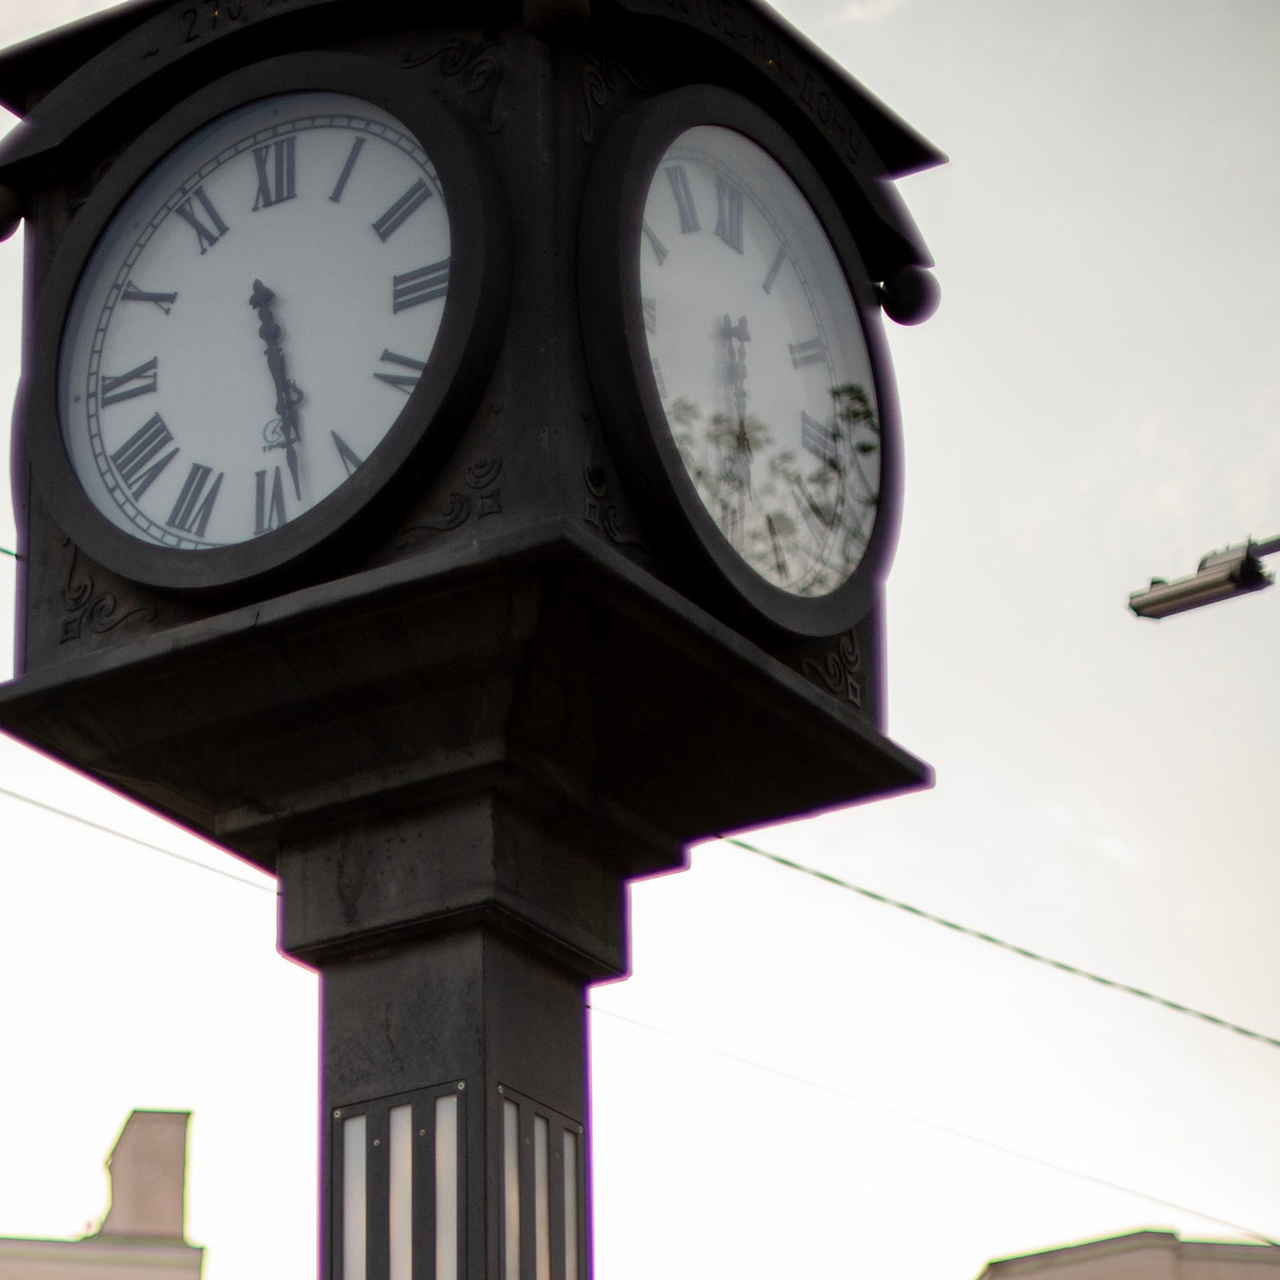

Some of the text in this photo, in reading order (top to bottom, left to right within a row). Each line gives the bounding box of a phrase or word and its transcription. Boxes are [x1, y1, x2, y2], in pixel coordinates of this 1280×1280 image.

[251, 136, 297, 212] XII
[328, 136, 367, 203] I
[175, 186, 230, 255] XI
[371, 177, 433, 242] II
[121, 281, 178, 315] X
[392, 257, 451, 313] III
[101, 356, 158, 409] IX
[110, 411, 179, 501] VIII
[165, 463, 225, 538] VII
[253, 467, 288, 537] VI
